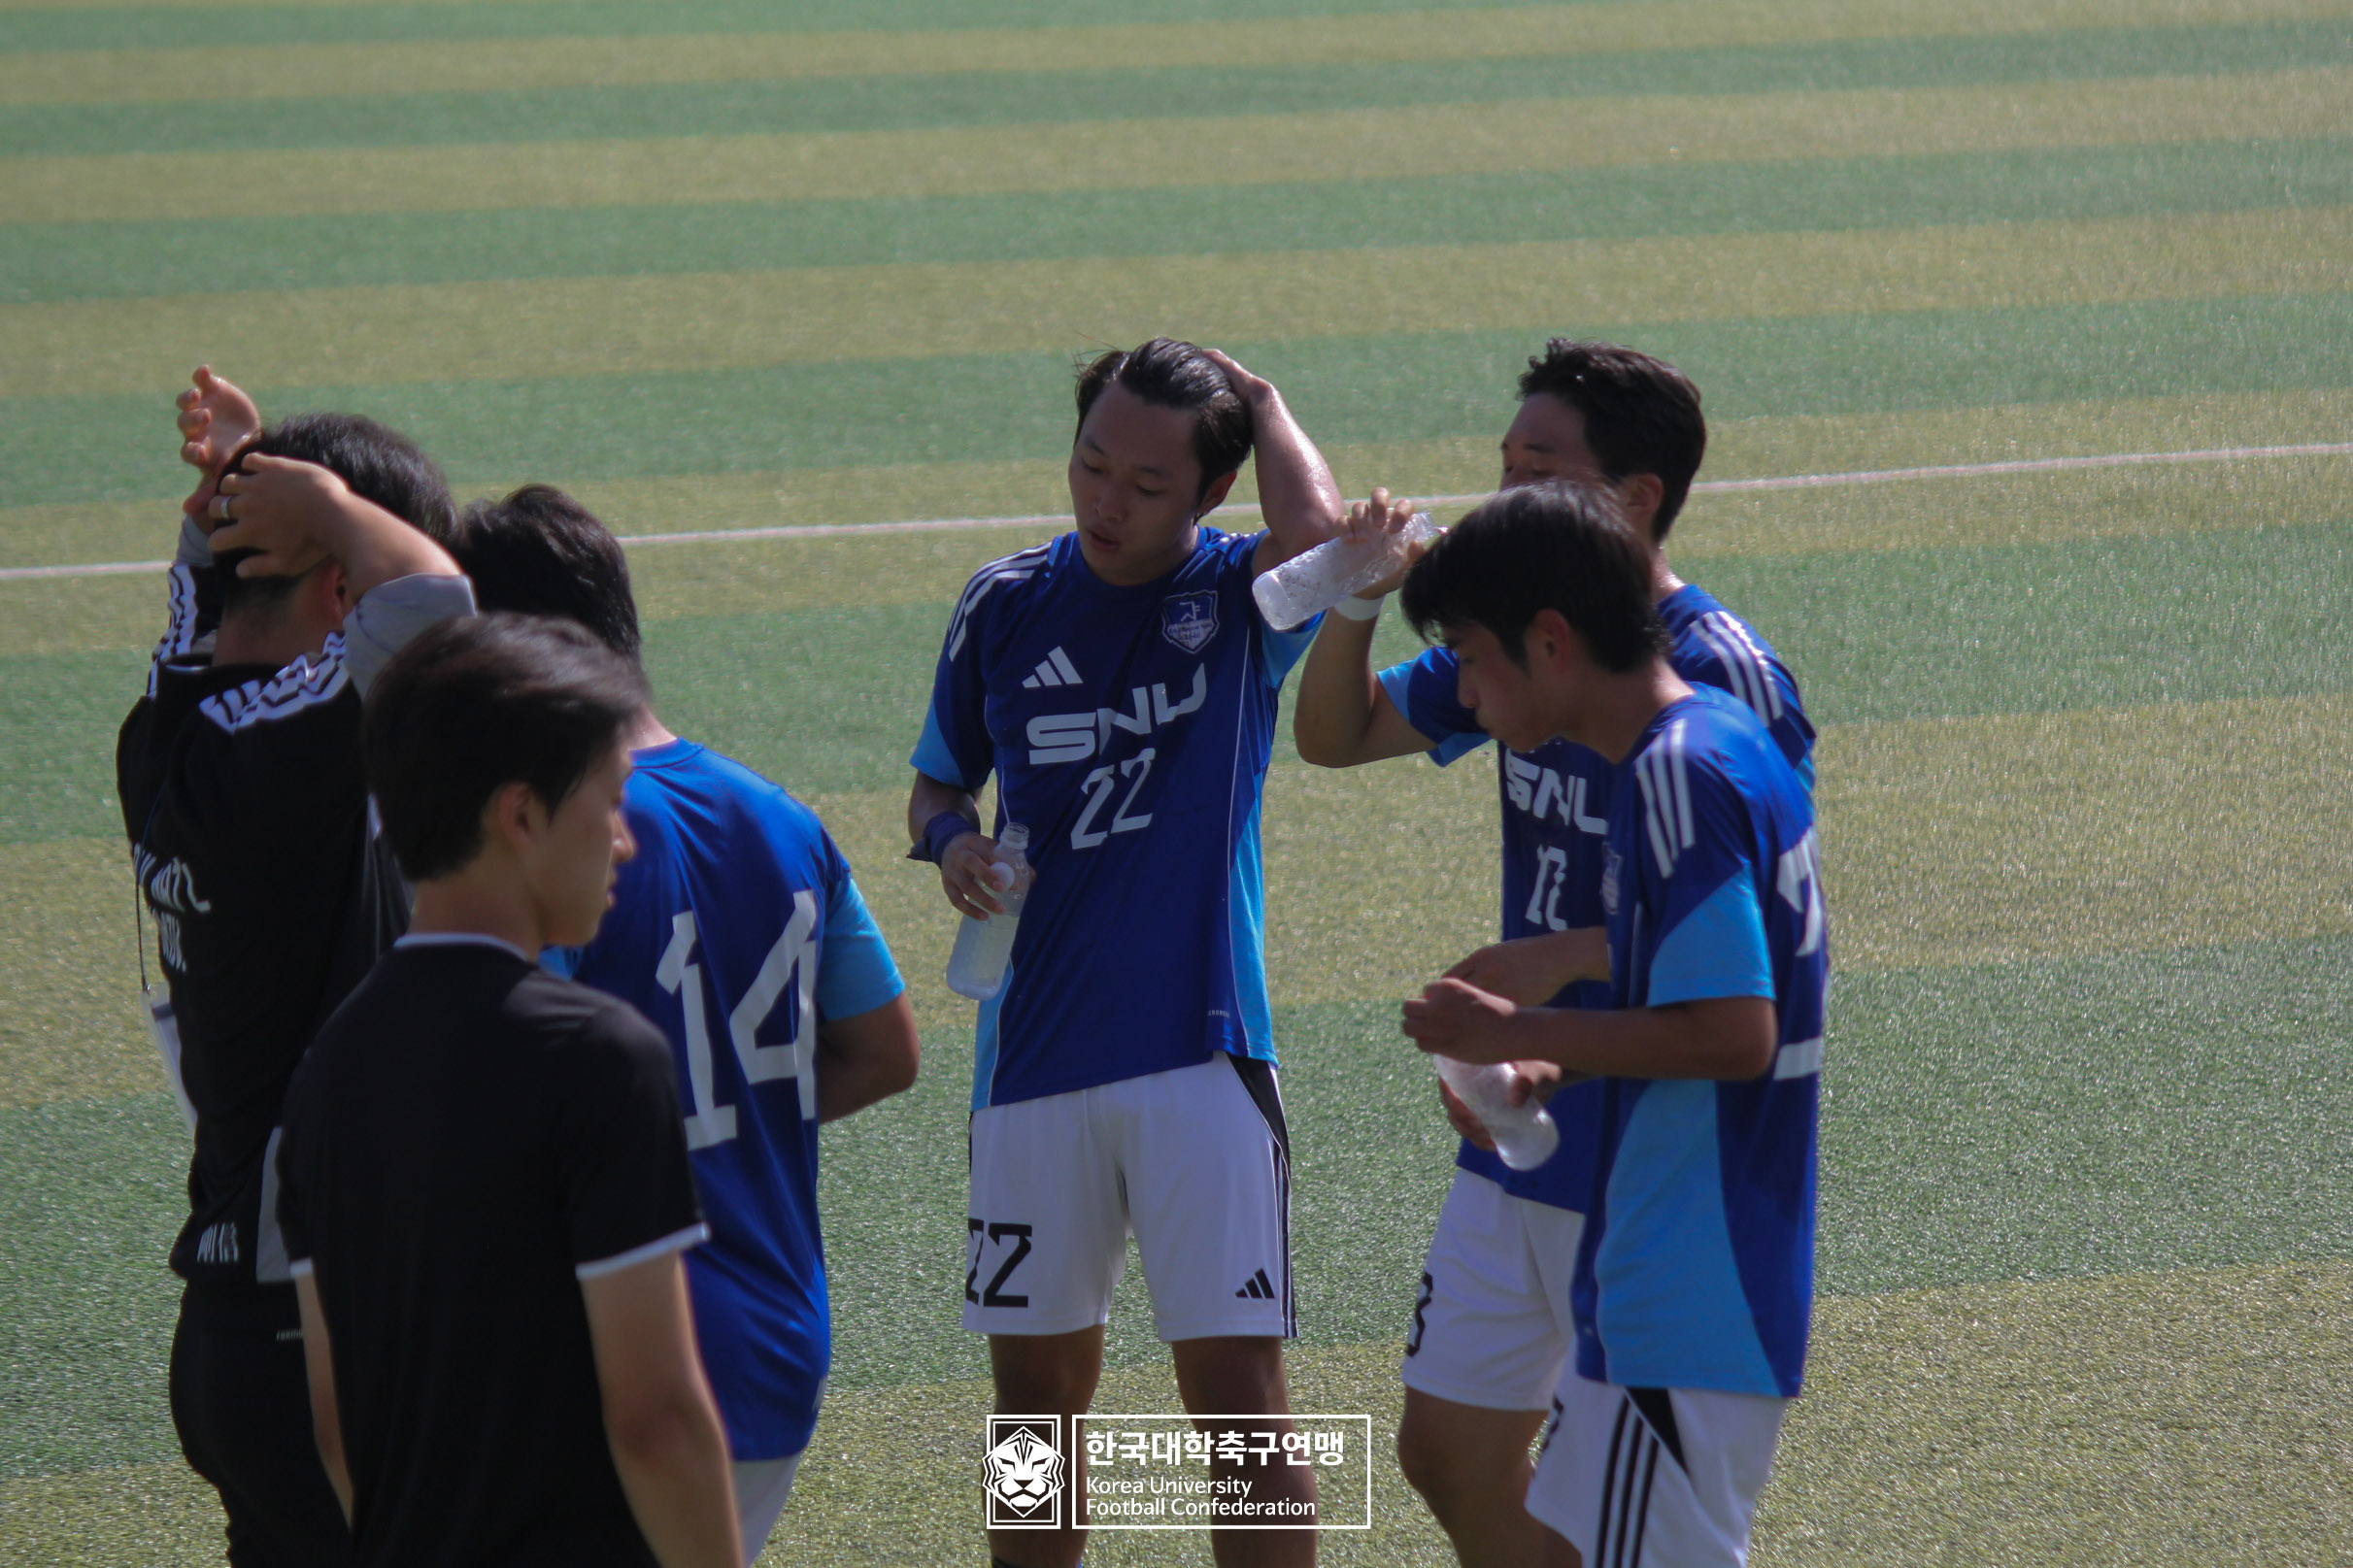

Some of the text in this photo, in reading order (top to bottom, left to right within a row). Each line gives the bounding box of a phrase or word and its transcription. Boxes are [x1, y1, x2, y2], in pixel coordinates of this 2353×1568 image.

[1025, 662, 1207, 765] SNU
[1070, 748, 1156, 850] 22
[655, 888, 817, 1151] 14
[965, 1217, 1032, 1308] 22
